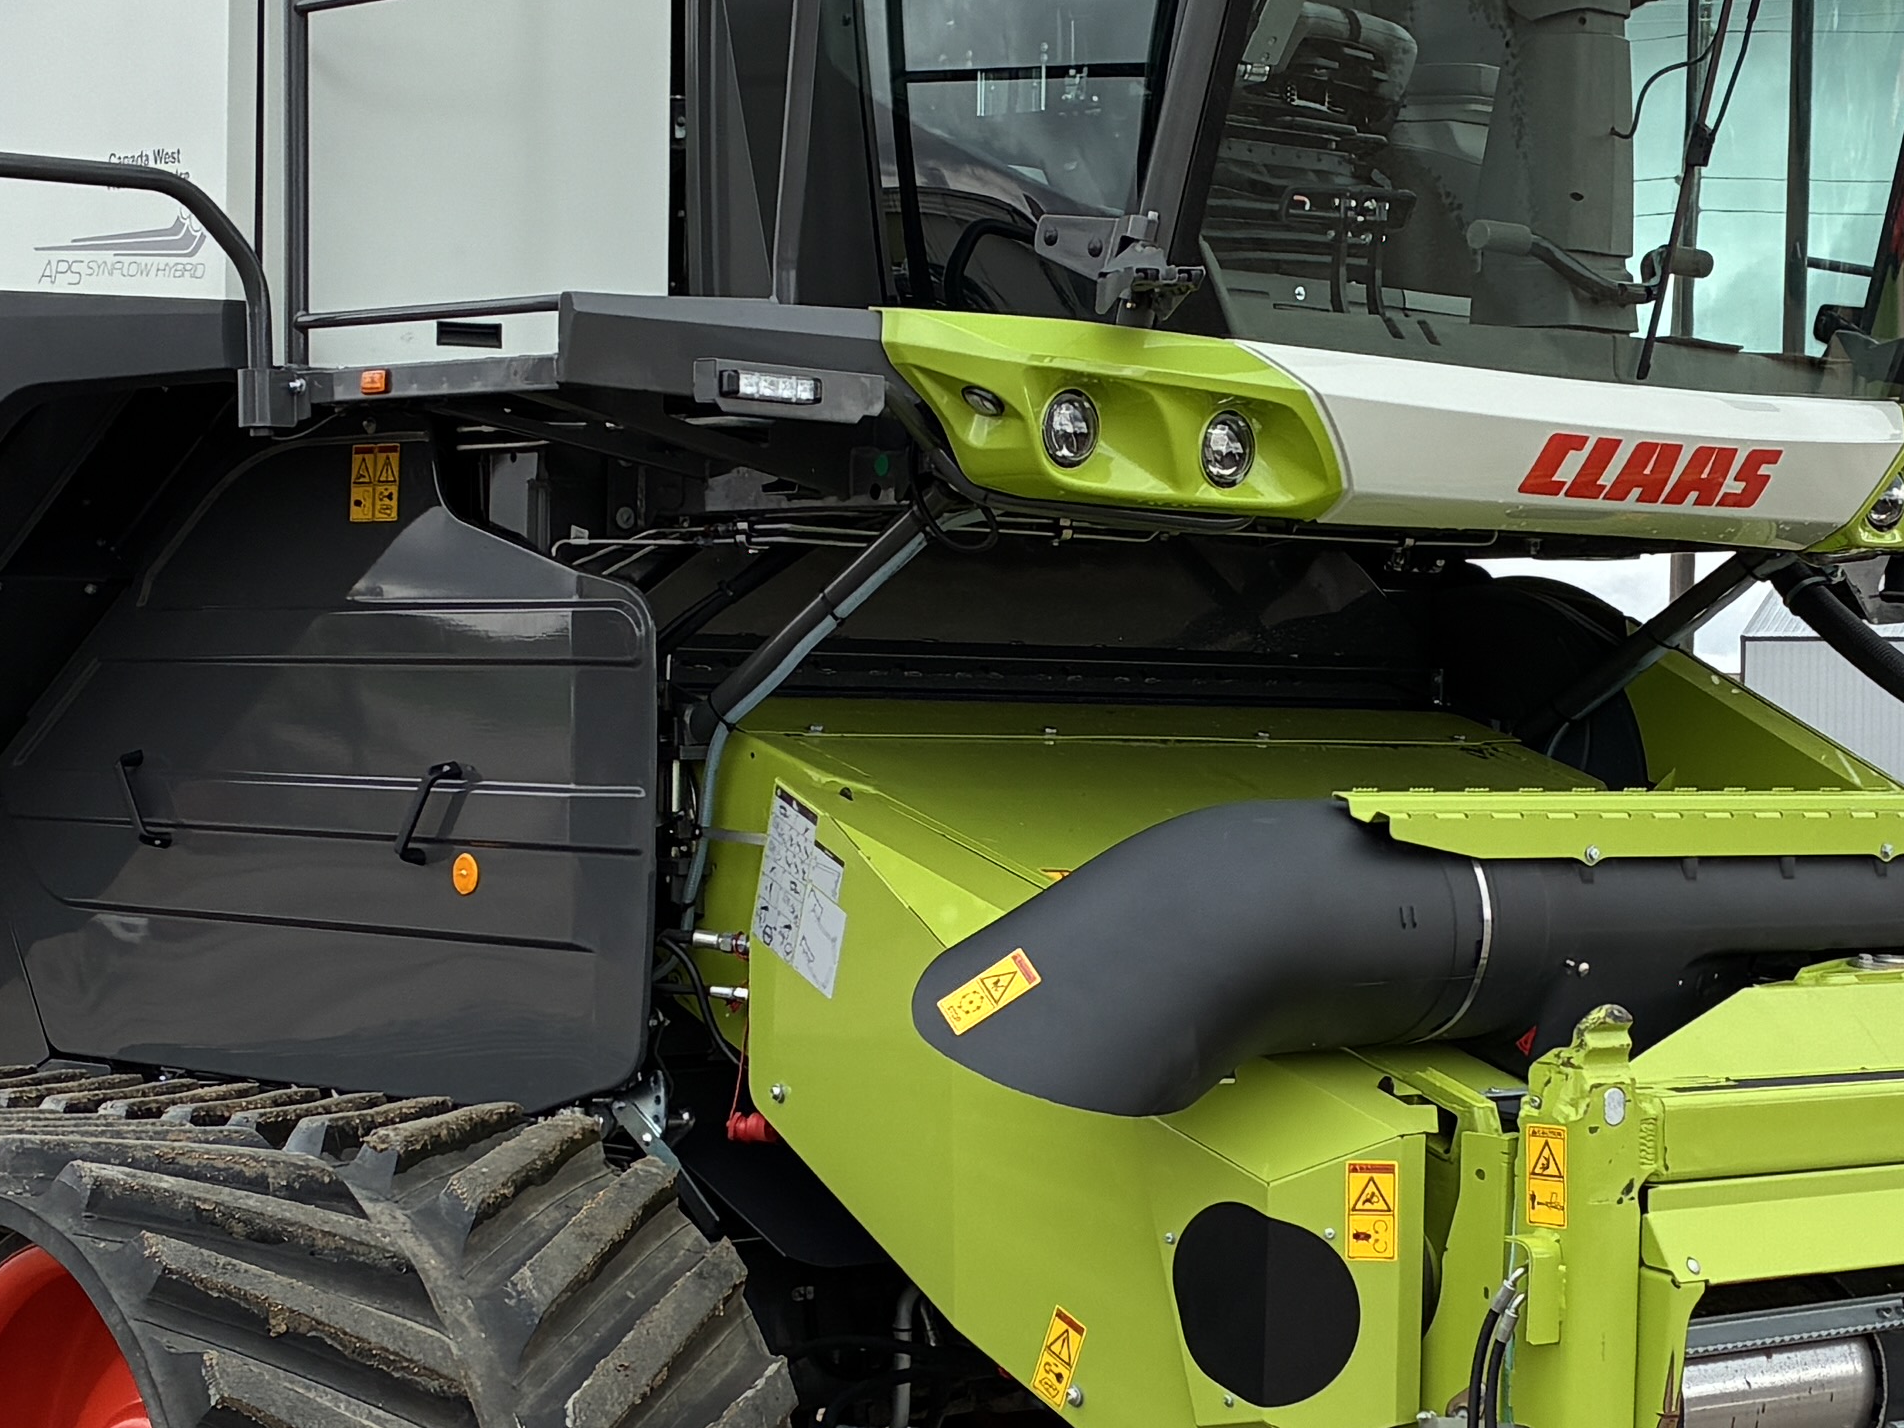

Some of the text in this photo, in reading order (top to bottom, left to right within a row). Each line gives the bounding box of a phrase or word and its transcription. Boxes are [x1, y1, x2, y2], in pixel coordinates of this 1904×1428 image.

[153, 148, 181, 165] West
[38, 259, 84, 285] APS
[155, 262, 205, 279] HYBRID
[1518, 432, 1784, 509] CLAAS
